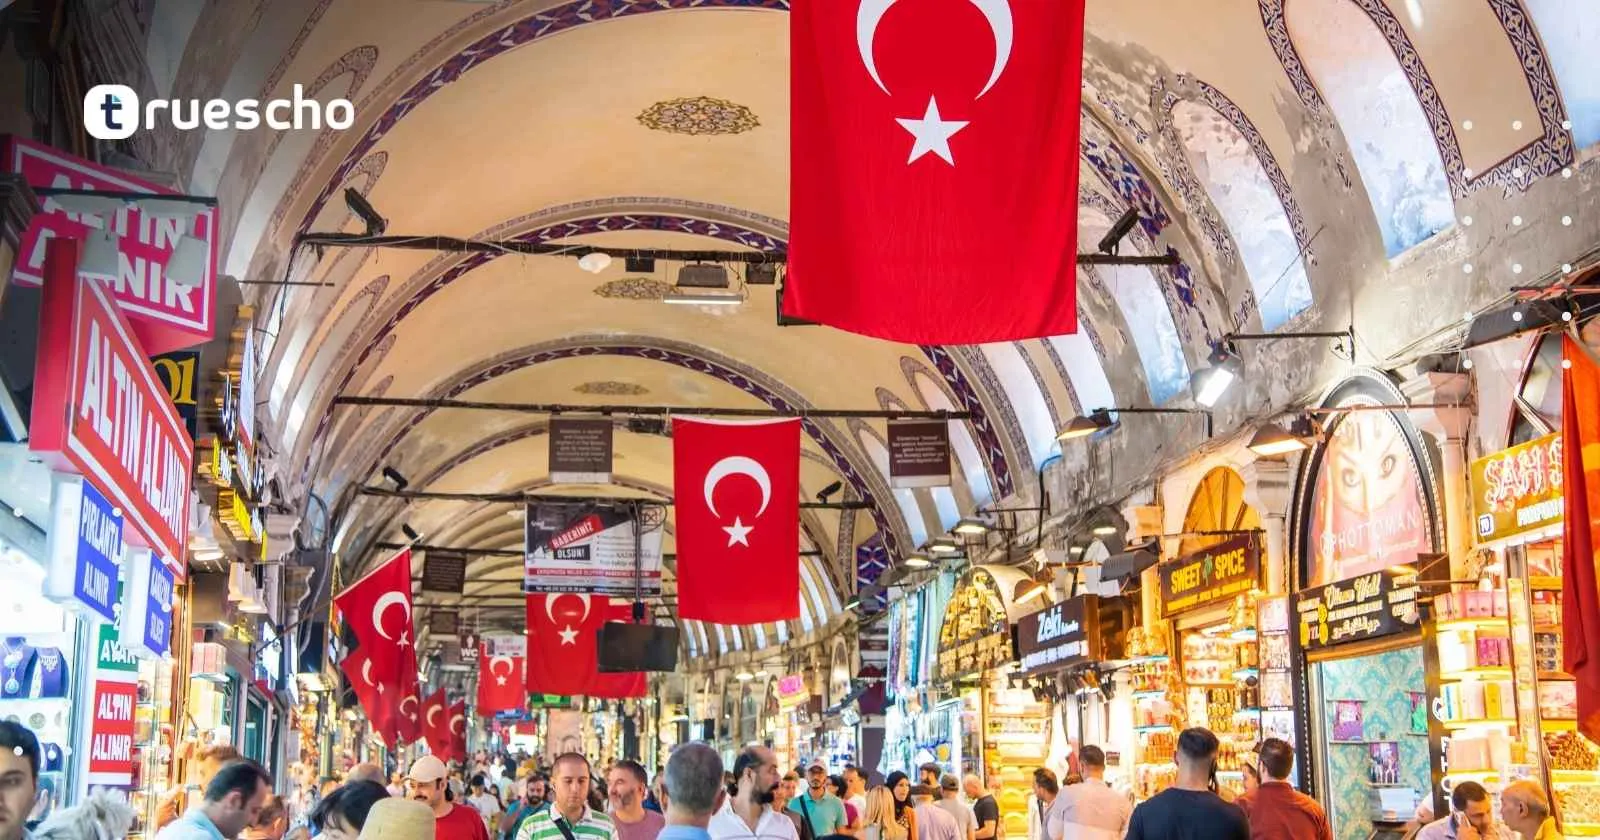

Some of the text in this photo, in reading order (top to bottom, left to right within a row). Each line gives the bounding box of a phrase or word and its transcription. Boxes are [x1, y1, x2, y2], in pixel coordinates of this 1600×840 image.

[81, 319, 186, 546] ALTIN ALINIR
[83, 561, 110, 608] ALINIR
[1171, 548, 1245, 594] SWEET SPICE
[1037, 605, 1062, 643] Zeki
[461, 648, 478, 657] WC
[98, 692, 131, 720] ALTIN
[92, 734, 131, 761] ALINIR
